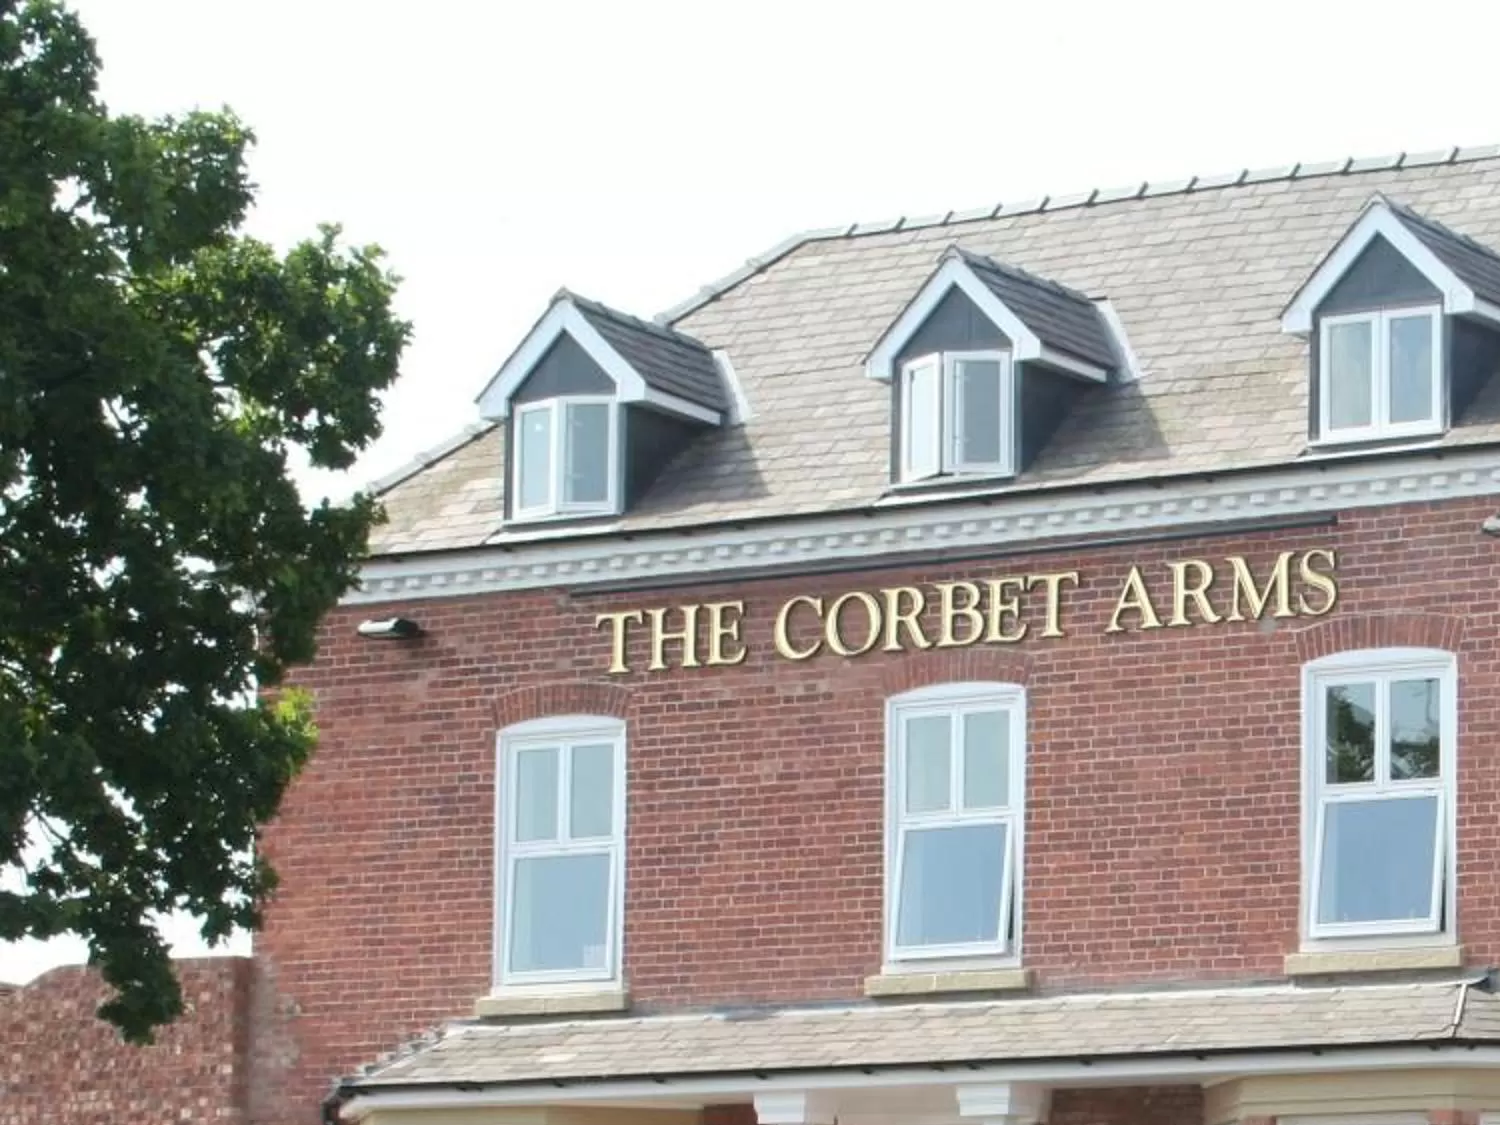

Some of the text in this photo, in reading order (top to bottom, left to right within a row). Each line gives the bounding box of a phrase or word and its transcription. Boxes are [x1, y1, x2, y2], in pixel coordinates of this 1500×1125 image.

[595, 549, 1339, 674] THE CORBET ARMS
